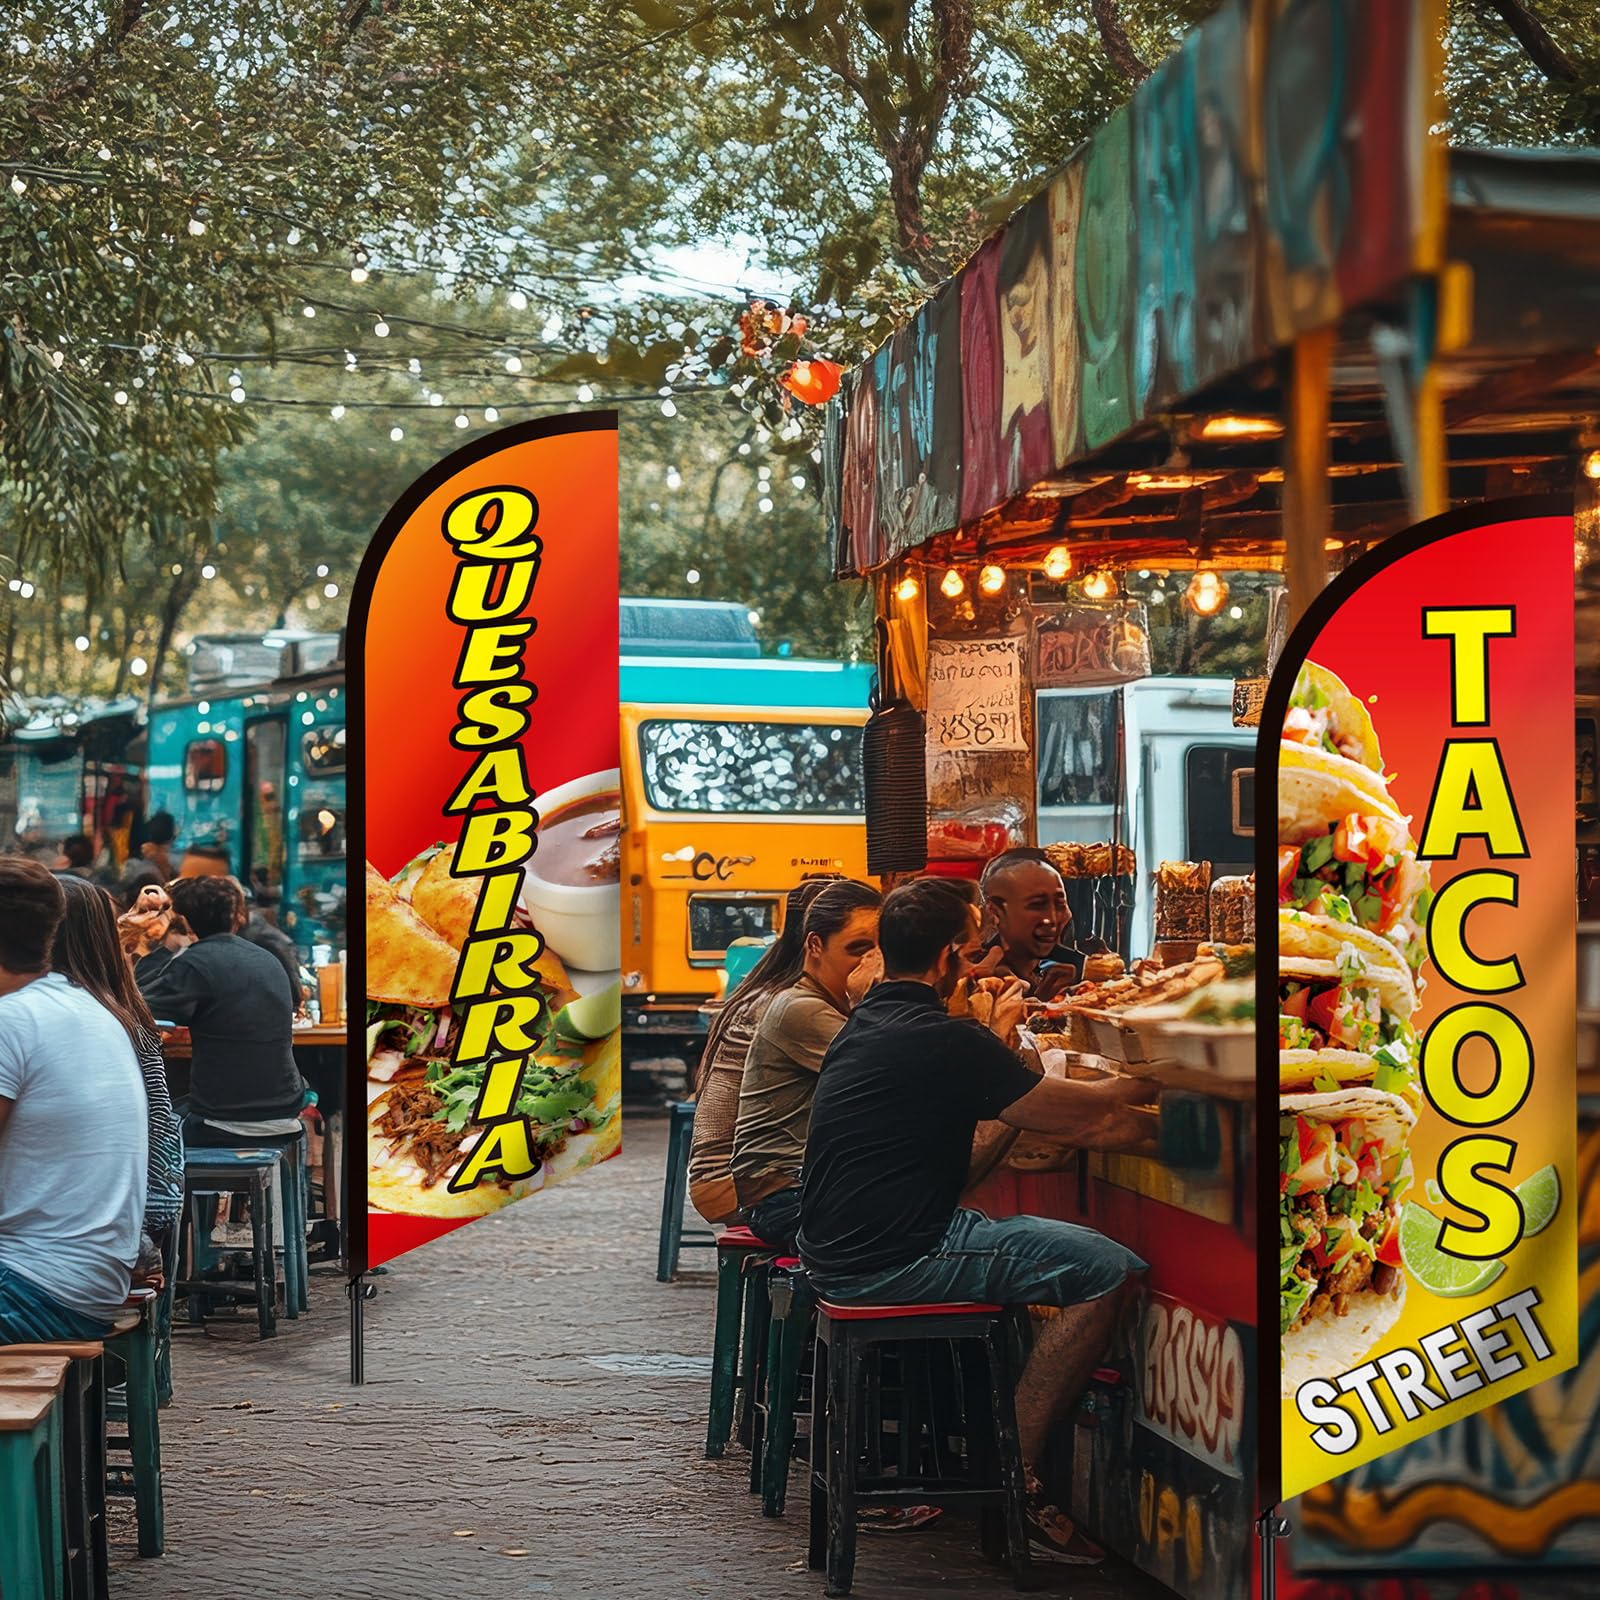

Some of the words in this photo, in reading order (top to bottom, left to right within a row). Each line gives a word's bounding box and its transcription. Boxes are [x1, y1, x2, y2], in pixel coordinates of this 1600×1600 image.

[442, 485, 544, 1193] QUESABIRRIA
[1416, 605, 1534, 1262] TACOS
[1296, 1288, 1554, 1456] STREET
